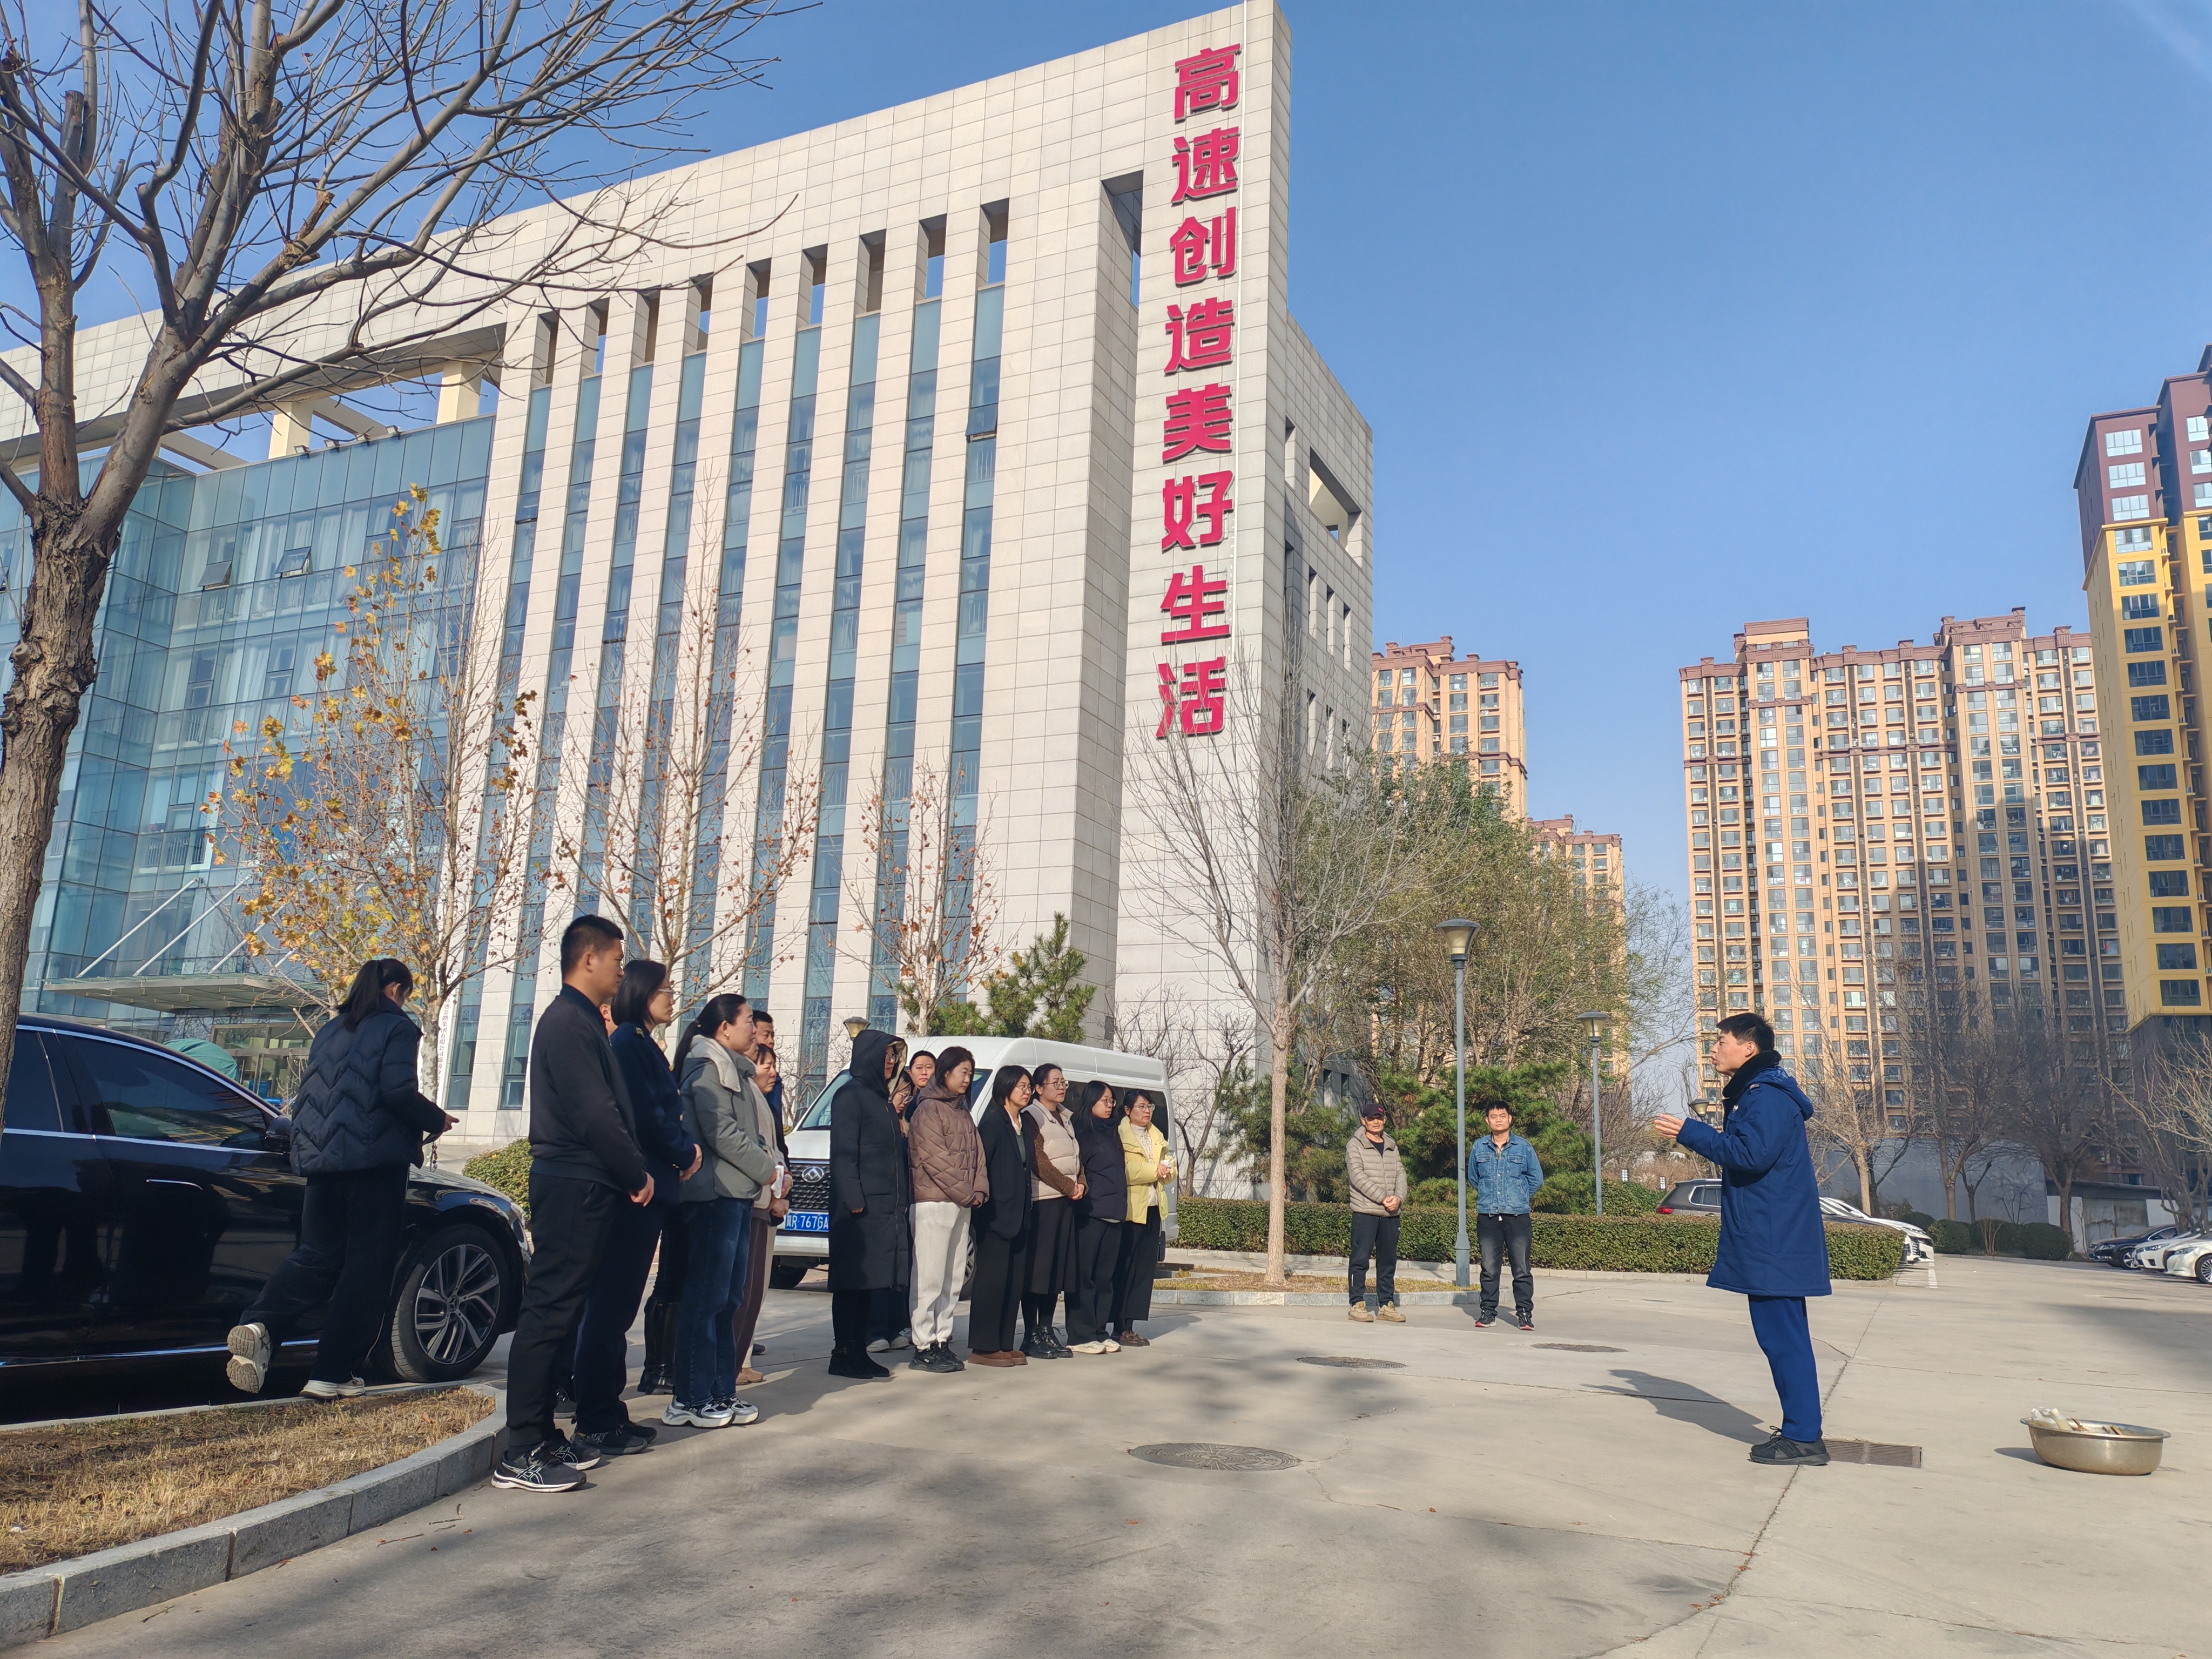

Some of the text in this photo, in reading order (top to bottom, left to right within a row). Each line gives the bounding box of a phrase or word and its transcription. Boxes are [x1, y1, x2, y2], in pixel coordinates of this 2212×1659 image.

[1156, 43, 1240, 737] 高速创造美好生活
